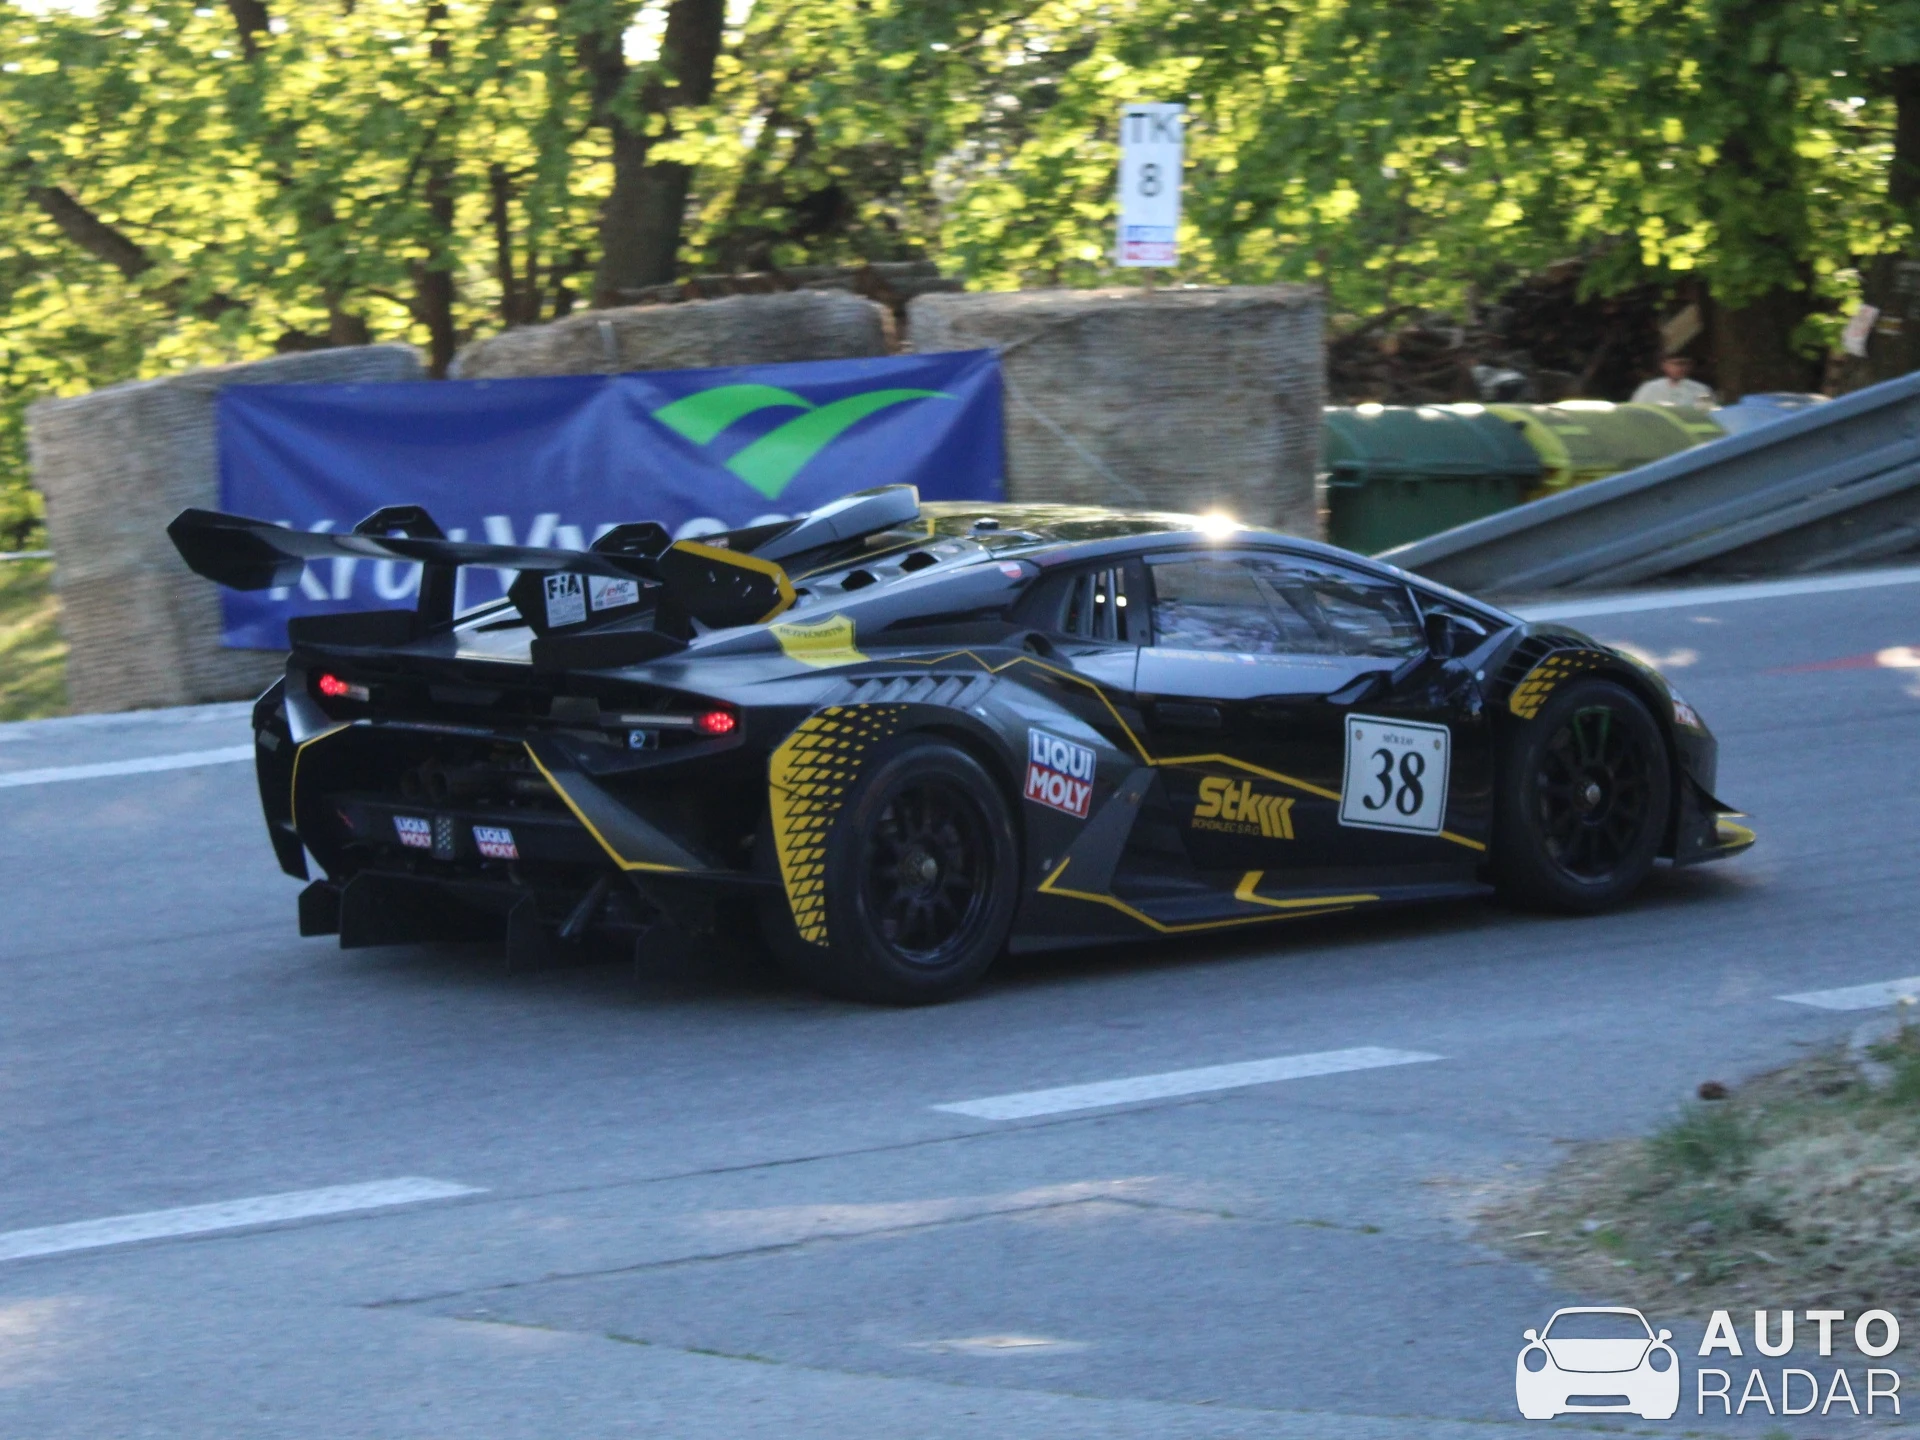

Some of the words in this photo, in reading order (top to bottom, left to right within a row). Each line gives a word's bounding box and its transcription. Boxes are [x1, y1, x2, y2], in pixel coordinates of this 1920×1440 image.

[1128, 113, 1182, 143] TK
[1138, 163, 1162, 197] 8
[1032, 732, 1092, 781] LIQUI
[1028, 766, 1090, 813] MOLY
[1362, 748, 1425, 816] 38
[474, 826, 513, 844] LIQUI
[480, 842, 517, 859] MOLY
